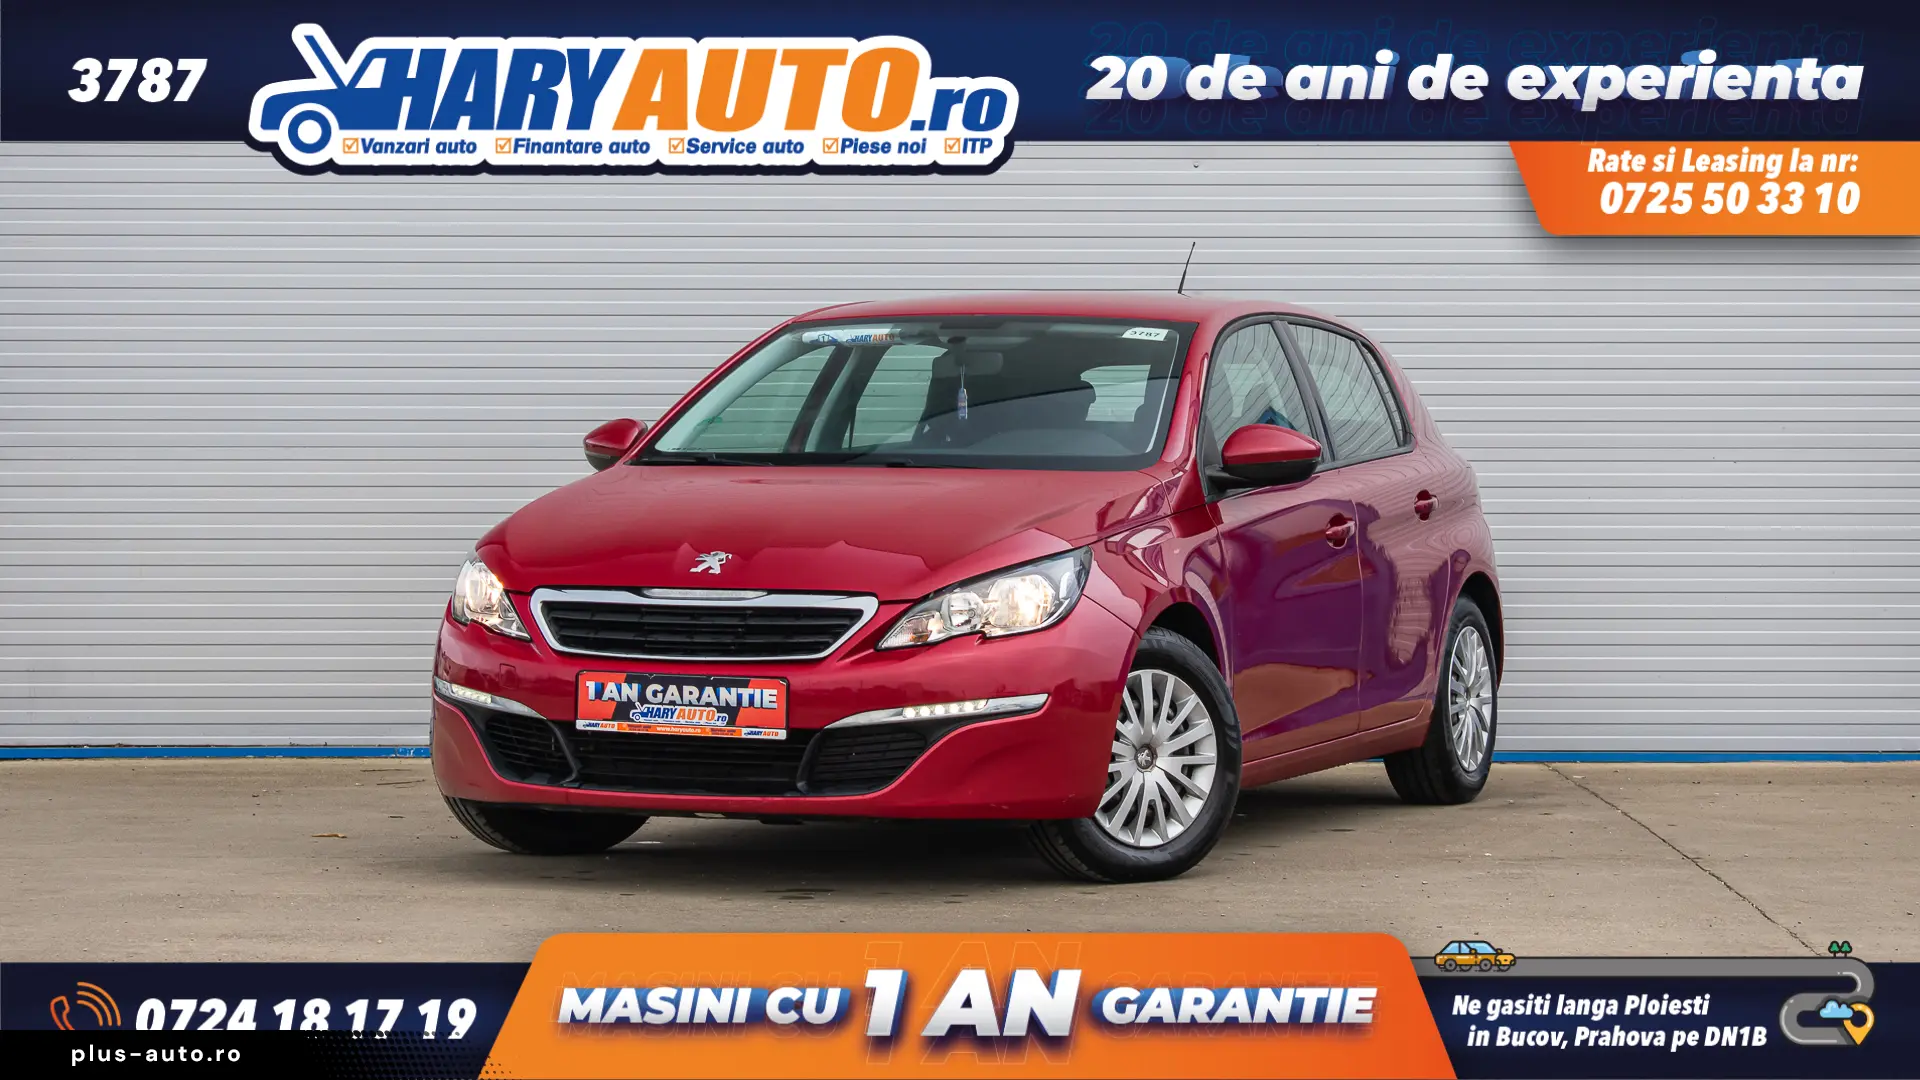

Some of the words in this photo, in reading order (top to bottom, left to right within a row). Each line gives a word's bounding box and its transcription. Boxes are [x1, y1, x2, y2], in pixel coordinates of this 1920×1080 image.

[585, 681, 596, 701] 1
[602, 681, 639, 702] AN
[645, 683, 778, 709] GARANTIE
[645, 706, 728, 722] HARYAUTO.ro
